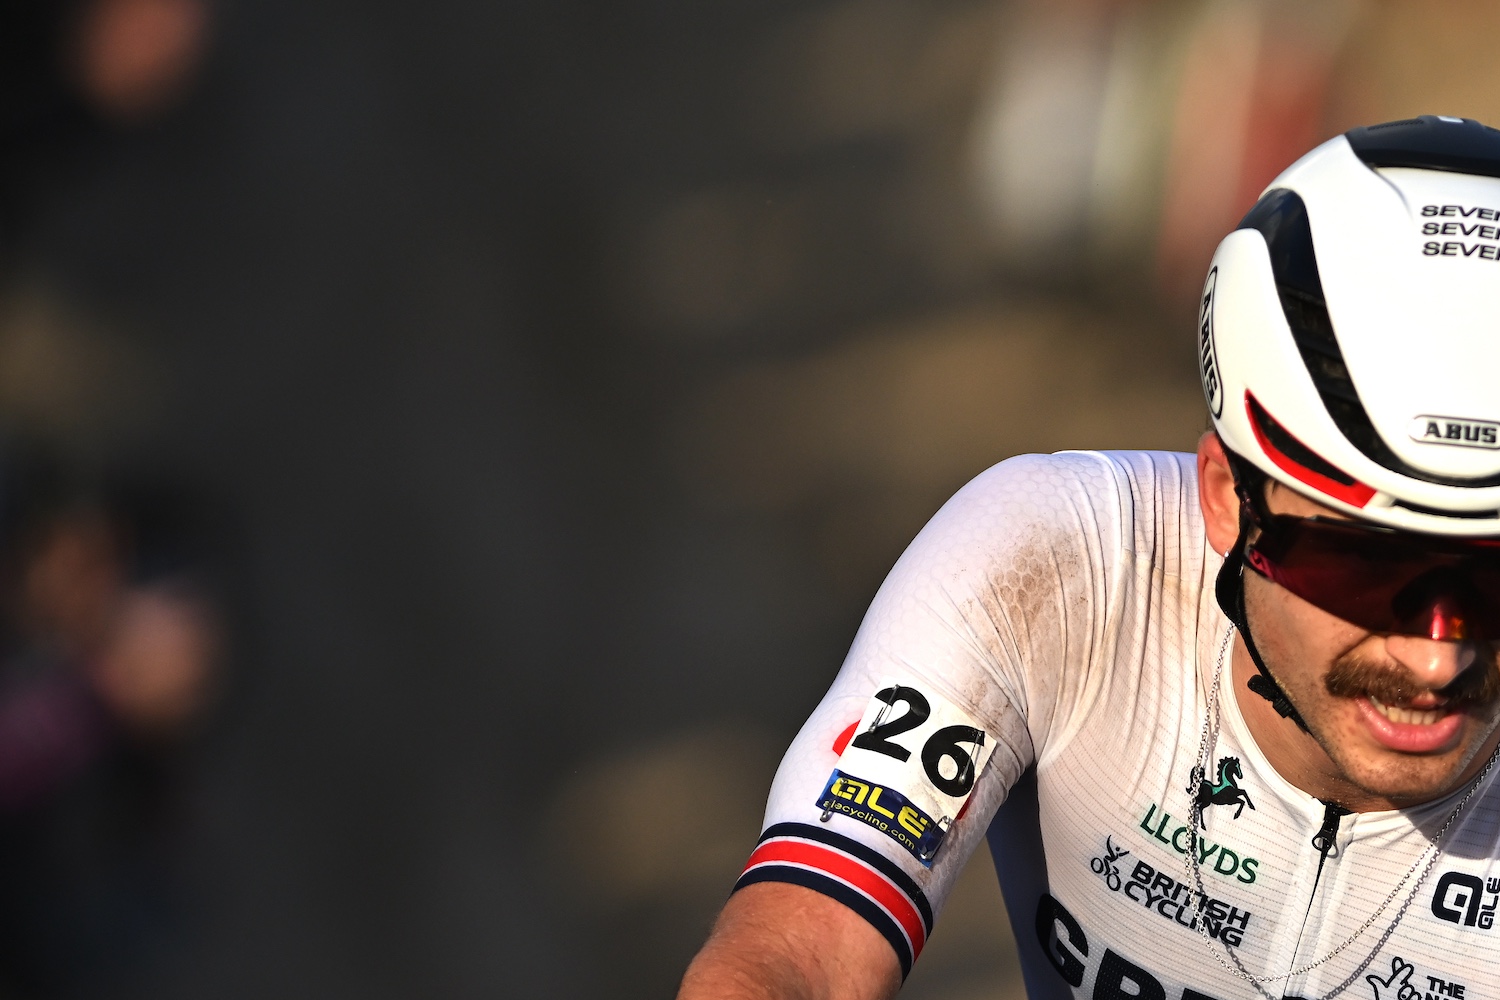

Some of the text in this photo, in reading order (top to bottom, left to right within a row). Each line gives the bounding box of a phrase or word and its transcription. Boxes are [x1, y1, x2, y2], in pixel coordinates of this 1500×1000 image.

[1424, 421, 1497, 443] ABUS
[852, 686, 985, 797] 26
[1140, 803, 1259, 883] LLOYDS
[1125, 881, 1245, 947] CYCLING
[1131, 860, 1251, 930] BRITISH
[1427, 976, 1465, 1000] THE
